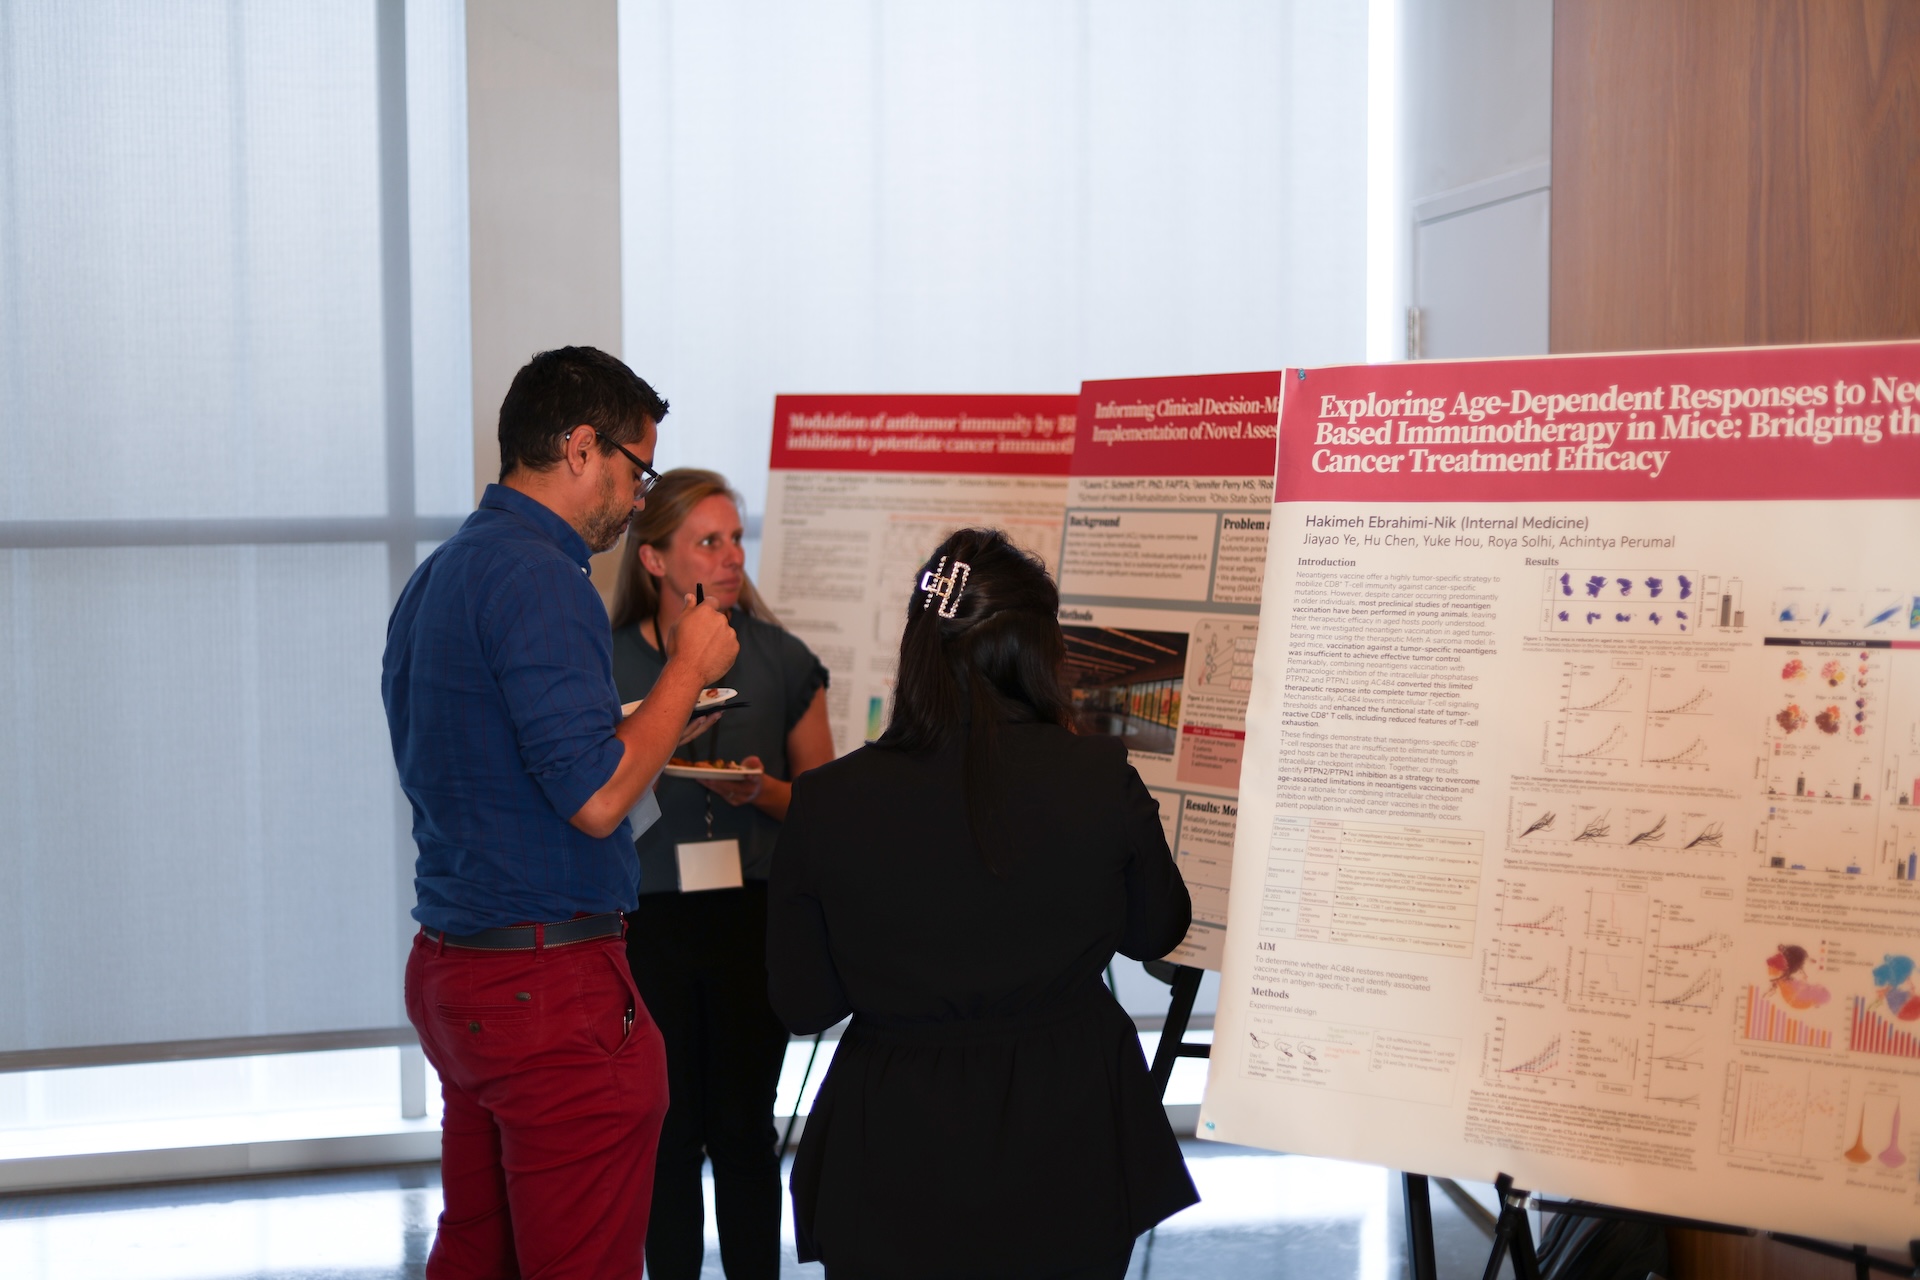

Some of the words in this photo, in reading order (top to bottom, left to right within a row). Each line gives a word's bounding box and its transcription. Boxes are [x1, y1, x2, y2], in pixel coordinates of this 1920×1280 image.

[1318, 390, 1447, 424] Exploring
[1449, 384, 1665, 422] Age-Dependent
[1669, 384, 1828, 416] Responses
[1834, 380, 1866, 405] to
[1871, 376, 1920, 403] Ne
[1094, 399, 1154, 422] Informing
[1156, 397, 1203, 417] Clinical
[1205, 395, 1278, 414] Decision-M
[789, 412, 868, 430] Modulation
[870, 411, 887, 430] of
[887, 413, 957, 431] antitumor
[960, 412, 1032, 437] immunity
[1035, 413, 1054, 437] by
[1314, 420, 1392, 445] Based
[1396, 416, 1623, 449] Immunotherapy
[1627, 413, 1656, 440] in
[1661, 411, 1743, 440] Mice:
[1748, 407, 1884, 444] Bridging
[1092, 422, 1188, 447] Implementation
[1189, 422, 1208, 440] of
[1205, 420, 1241, 440] Novel
[787, 433, 853, 450] inhibition
[856, 435, 870, 450] to
[870, 434, 942, 456] potentiate
[946, 439, 996, 453] cancer
[1311, 449, 1404, 473] Cancer
[1409, 448, 1552, 472] Treatment
[1556, 444, 1671, 478] Efficacy
[1069, 516, 1120, 528] Background
[1224, 518, 1265, 530] Problem
[1305, 515, 1364, 528] Hakimeh
[1368, 515, 1456, 529] Ebrahimi-Nik
[1461, 516, 1518, 531] (Internal
[1522, 516, 1589, 531] Medicine)
[1303, 533, 1339, 547] Jiayao
[1343, 534, 1360, 547] Ye,
[1364, 534, 1381, 545] Hu
[1384, 534, 1420, 547] Chen,
[1423, 535, 1451, 546] Yuke
[1454, 535, 1484, 548] Hou,
[1488, 536, 1517, 550] Roya
[1521, 535, 1555, 549] Solhi,
[1559, 535, 1616, 550] Achintya
[1620, 535, 1676, 548] Perumal
[1297, 557, 1356, 567] Introduction
[1525, 557, 1559, 566] Results
[1292, 606, 1331, 614] vaccination
[1332, 607, 1349, 615] have
[1350, 607, 1368, 615] been
[1369, 608, 1407, 618] performed
[1416, 611, 1438, 619] young
[1377, 599, 1413, 609] preclinical
[1414, 600, 1440, 608] studies
[1450, 602, 1491, 612] neoantigen
[1303, 649, 1342, 658] insufficient
[1352, 652, 1378, 660] achieve
[1380, 652, 1410, 661] effective
[1412, 654, 1432, 662] tumor
[1326, 642, 1365, 651] vaccination
[1366, 644, 1392, 653] against
[1400, 645, 1451, 655] tumor-specific
[1453, 647, 1497, 657] neoantigens
[1285, 684, 1323, 695] therapeutic
[1325, 687, 1355, 696] response
[1357, 687, 1371, 695] into
[1372, 688, 1404, 698] complete
[1433, 681, 1446, 689] this
[1448, 682, 1473, 690] limited
[1332, 704, 1366, 712] enhanced
[1367, 705, 1379, 713] the
[1380, 706, 1415, 715] functional
[1436, 708, 1444, 716] of
[1445, 709, 1471, 717] tumor-
[1282, 711, 1309, 719] reactive
[1337, 713, 1354, 722] cells,
[1355, 713, 1387, 725] including
[1388, 715, 1416, 724] reduced
[1418, 716, 1447, 725] features
[1449, 718, 1456, 726] of
[1459, 718, 1479, 727] T-cell
[1303, 767, 1353, 777] PTPN2/PTPN1
[1355, 770, 1387, 780] inhibition
[1405, 774, 1432, 785] strategy
[1277, 776, 1328, 785] age-associated
[1329, 778, 1364, 787] limitations
[1366, 780, 1373, 788] in
[1374, 782, 1416, 792] neoantigens
[1419, 784, 1458, 793] vaccination
[1186, 799, 1220, 814] Results:
[1256, 942, 1276, 951] AIM
[1255, 955, 1264, 963] To
[1265, 957, 1298, 967] determine
[1300, 961, 1329, 970] whether
[1330, 964, 1355, 973] AC484
[1356, 968, 1384, 977] restores
[1385, 971, 1428, 982] neoantigens
[1252, 974, 1280, 983] changes
[1289, 978, 1344, 991] antigen-specific
[1346, 984, 1364, 993] T-cell
[1366, 986, 1388, 996] states.
[1254, 965, 1279, 974] vaccine
[1280, 968, 1305, 977] efficacy
[1315, 971, 1333, 981] aged
[1334, 974, 1350, 982] mice
[1351, 975, 1365, 983] and
[1366, 977, 1392, 987] identify
[1393, 981, 1431, 991] associated
[1251, 986, 1290, 999] Methods
[1249, 1001, 1293, 1013] Experimental
[1294, 1006, 1317, 1016] design
